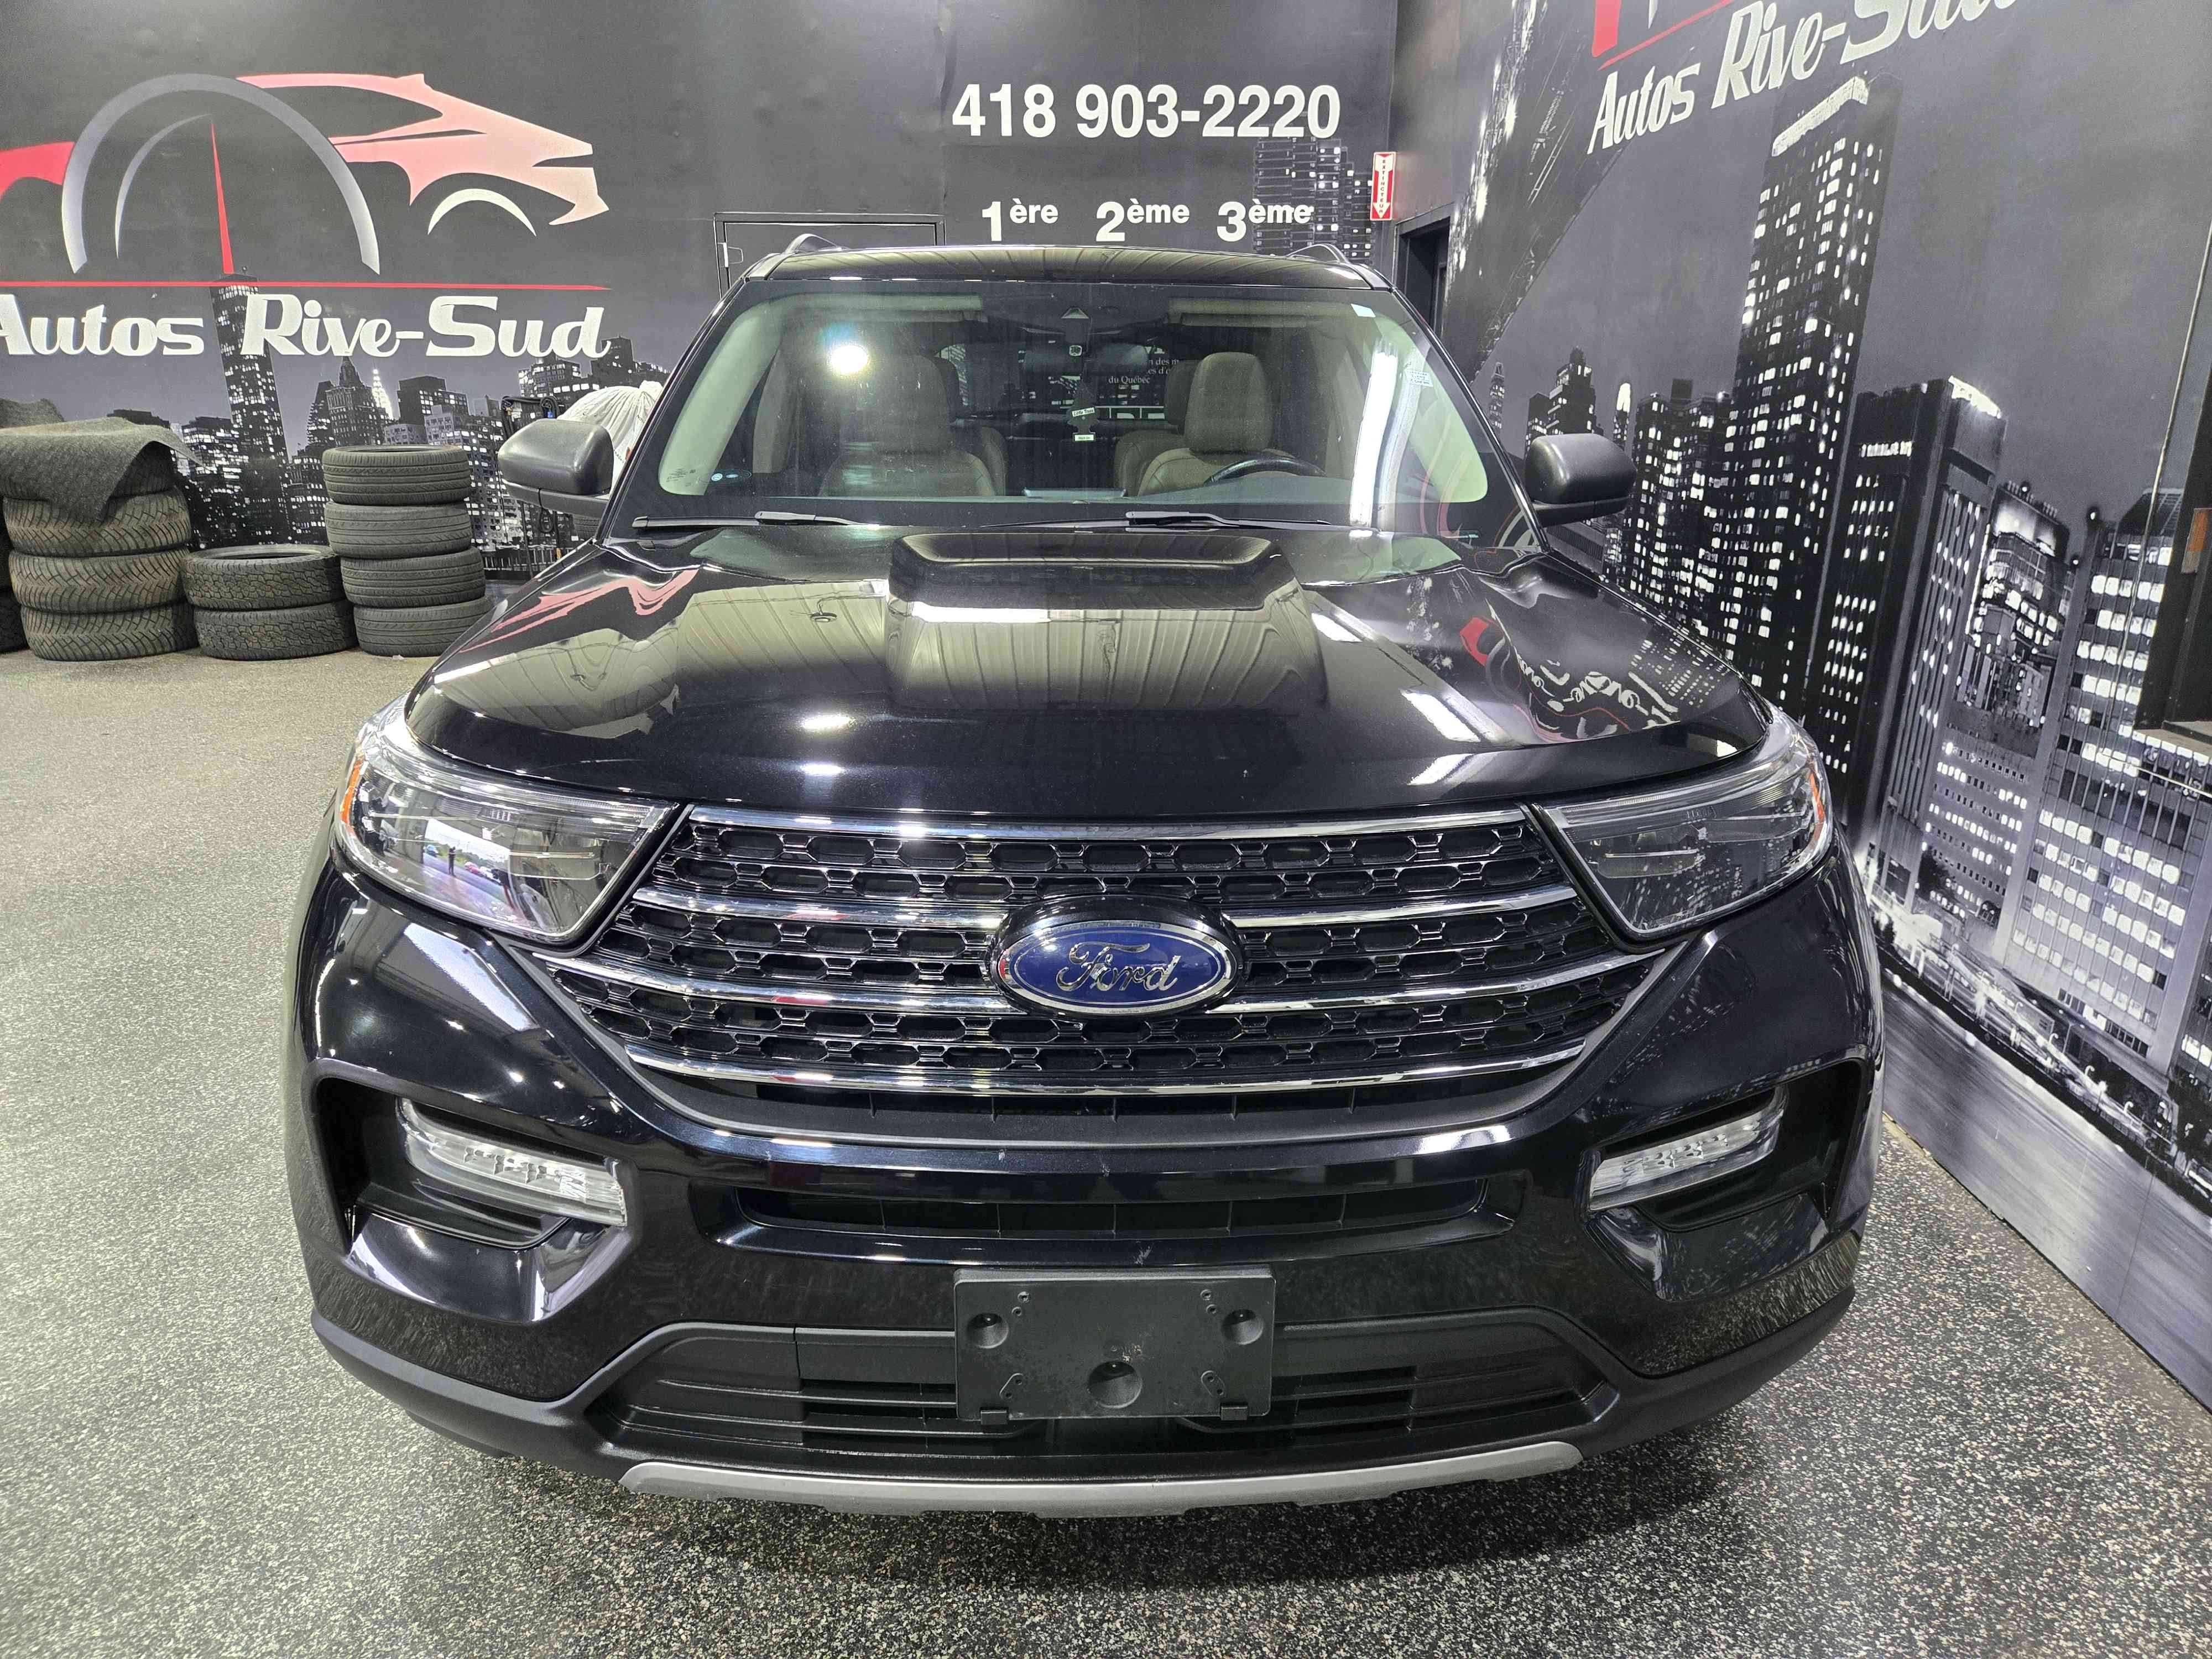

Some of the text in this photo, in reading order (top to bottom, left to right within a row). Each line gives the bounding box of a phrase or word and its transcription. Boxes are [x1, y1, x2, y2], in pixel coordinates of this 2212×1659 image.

[952, 84, 1340, 138] 418 903-2220
[1587, 62, 1700, 155] Autos
[982, 198, 1314, 242] 1ère 2ème 3ème
[0, 294, 612, 358] Autos Rive-Sud
[1056, 941, 1181, 992] Ford
